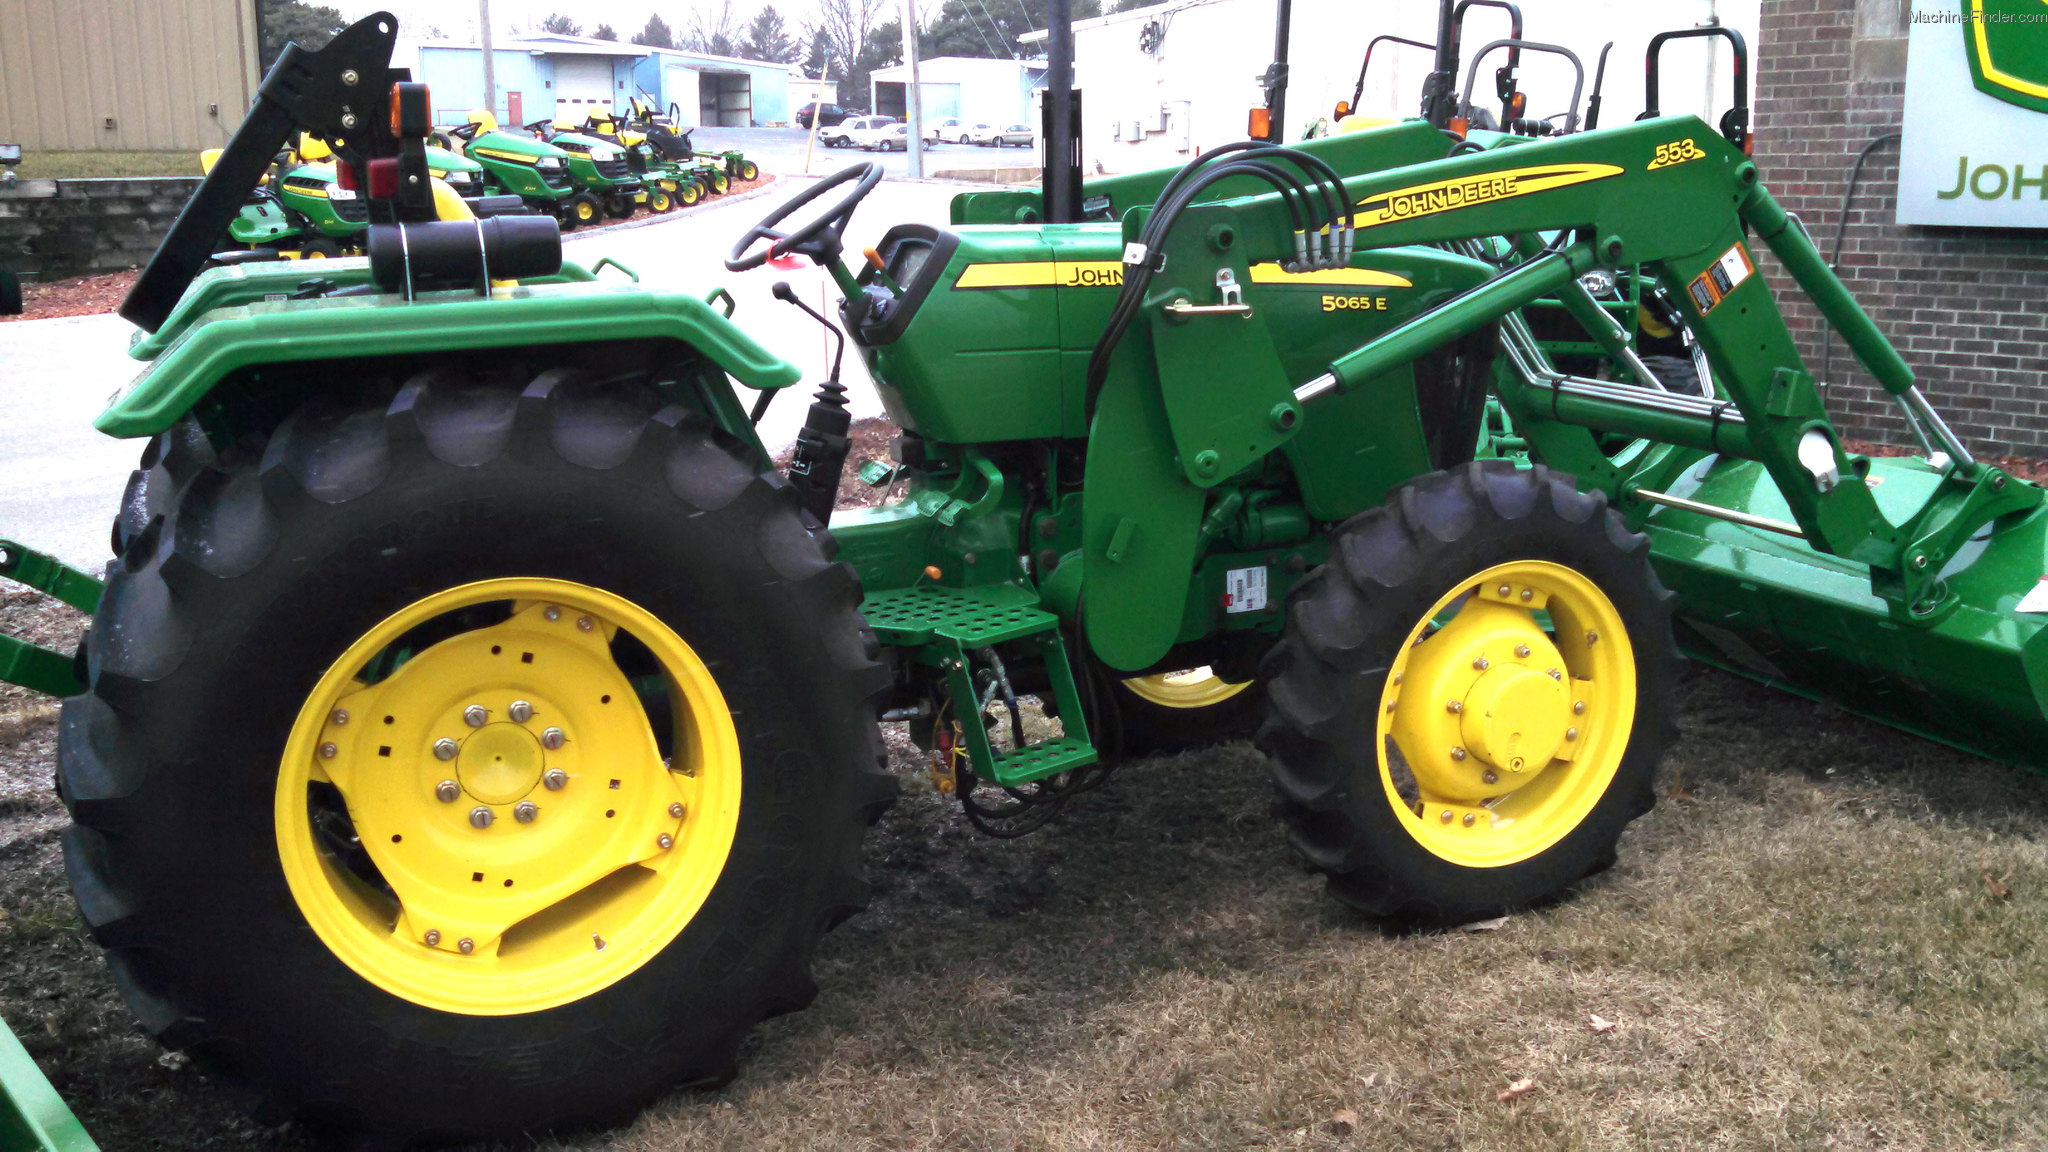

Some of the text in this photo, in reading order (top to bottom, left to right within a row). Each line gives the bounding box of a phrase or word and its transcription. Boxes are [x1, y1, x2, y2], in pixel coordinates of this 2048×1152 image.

[1655, 138, 1696, 165] 553
[1936, 156, 2048, 201] JOH
[1379, 176, 1518, 221] JOHN DEERE
[1321, 295, 1388, 312] 5065 E
